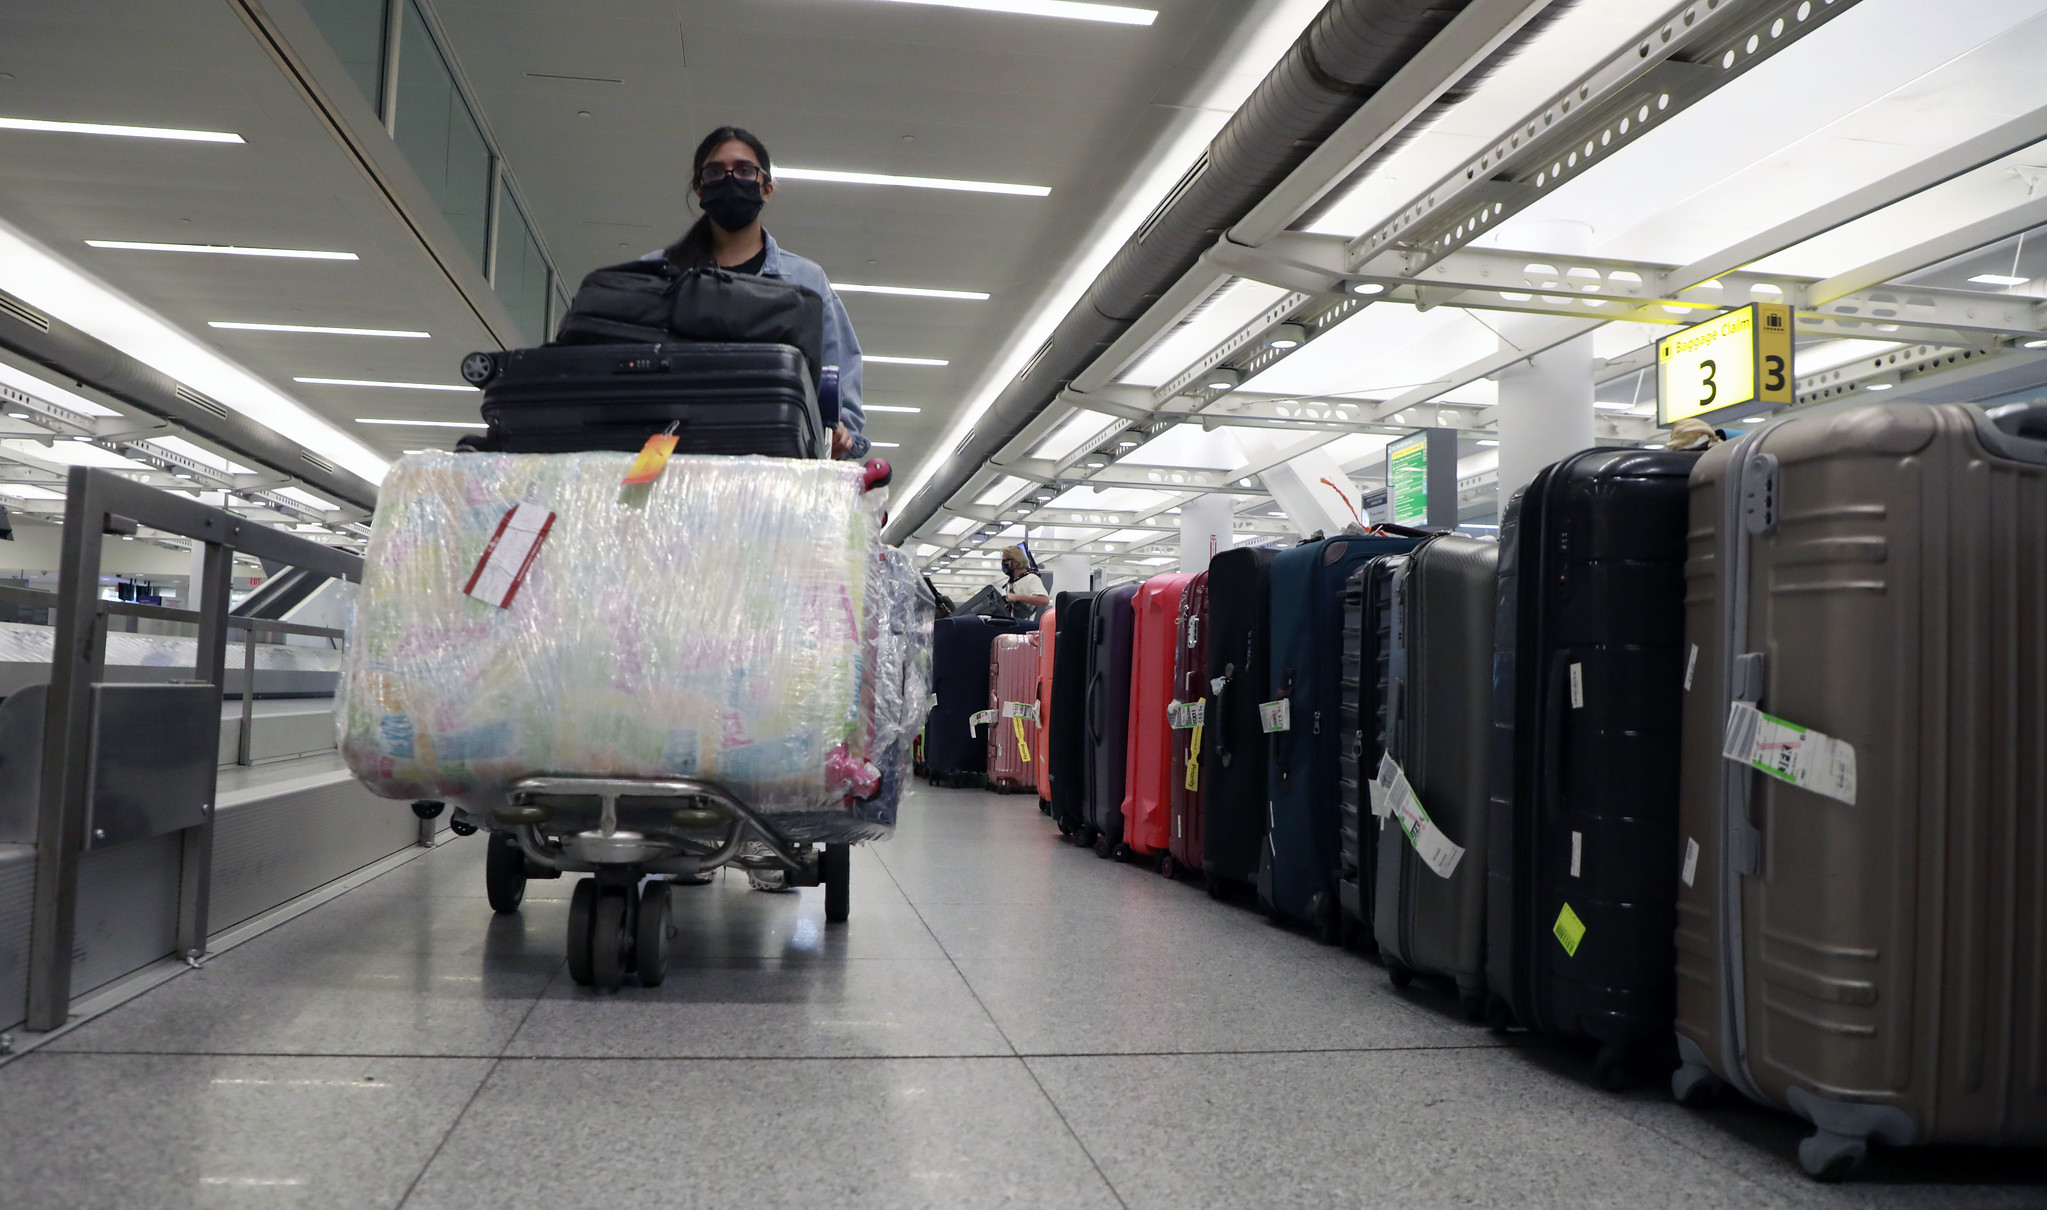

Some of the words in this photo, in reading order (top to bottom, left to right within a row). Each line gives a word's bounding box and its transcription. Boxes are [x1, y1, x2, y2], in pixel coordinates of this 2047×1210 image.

[1676, 330, 1718, 353] Baggage
[1720, 318, 1750, 337] Claim
[1699, 359, 1717, 406] 3
[1765, 355, 1785, 391] 3
[1188, 763, 1196, 789] Priority
